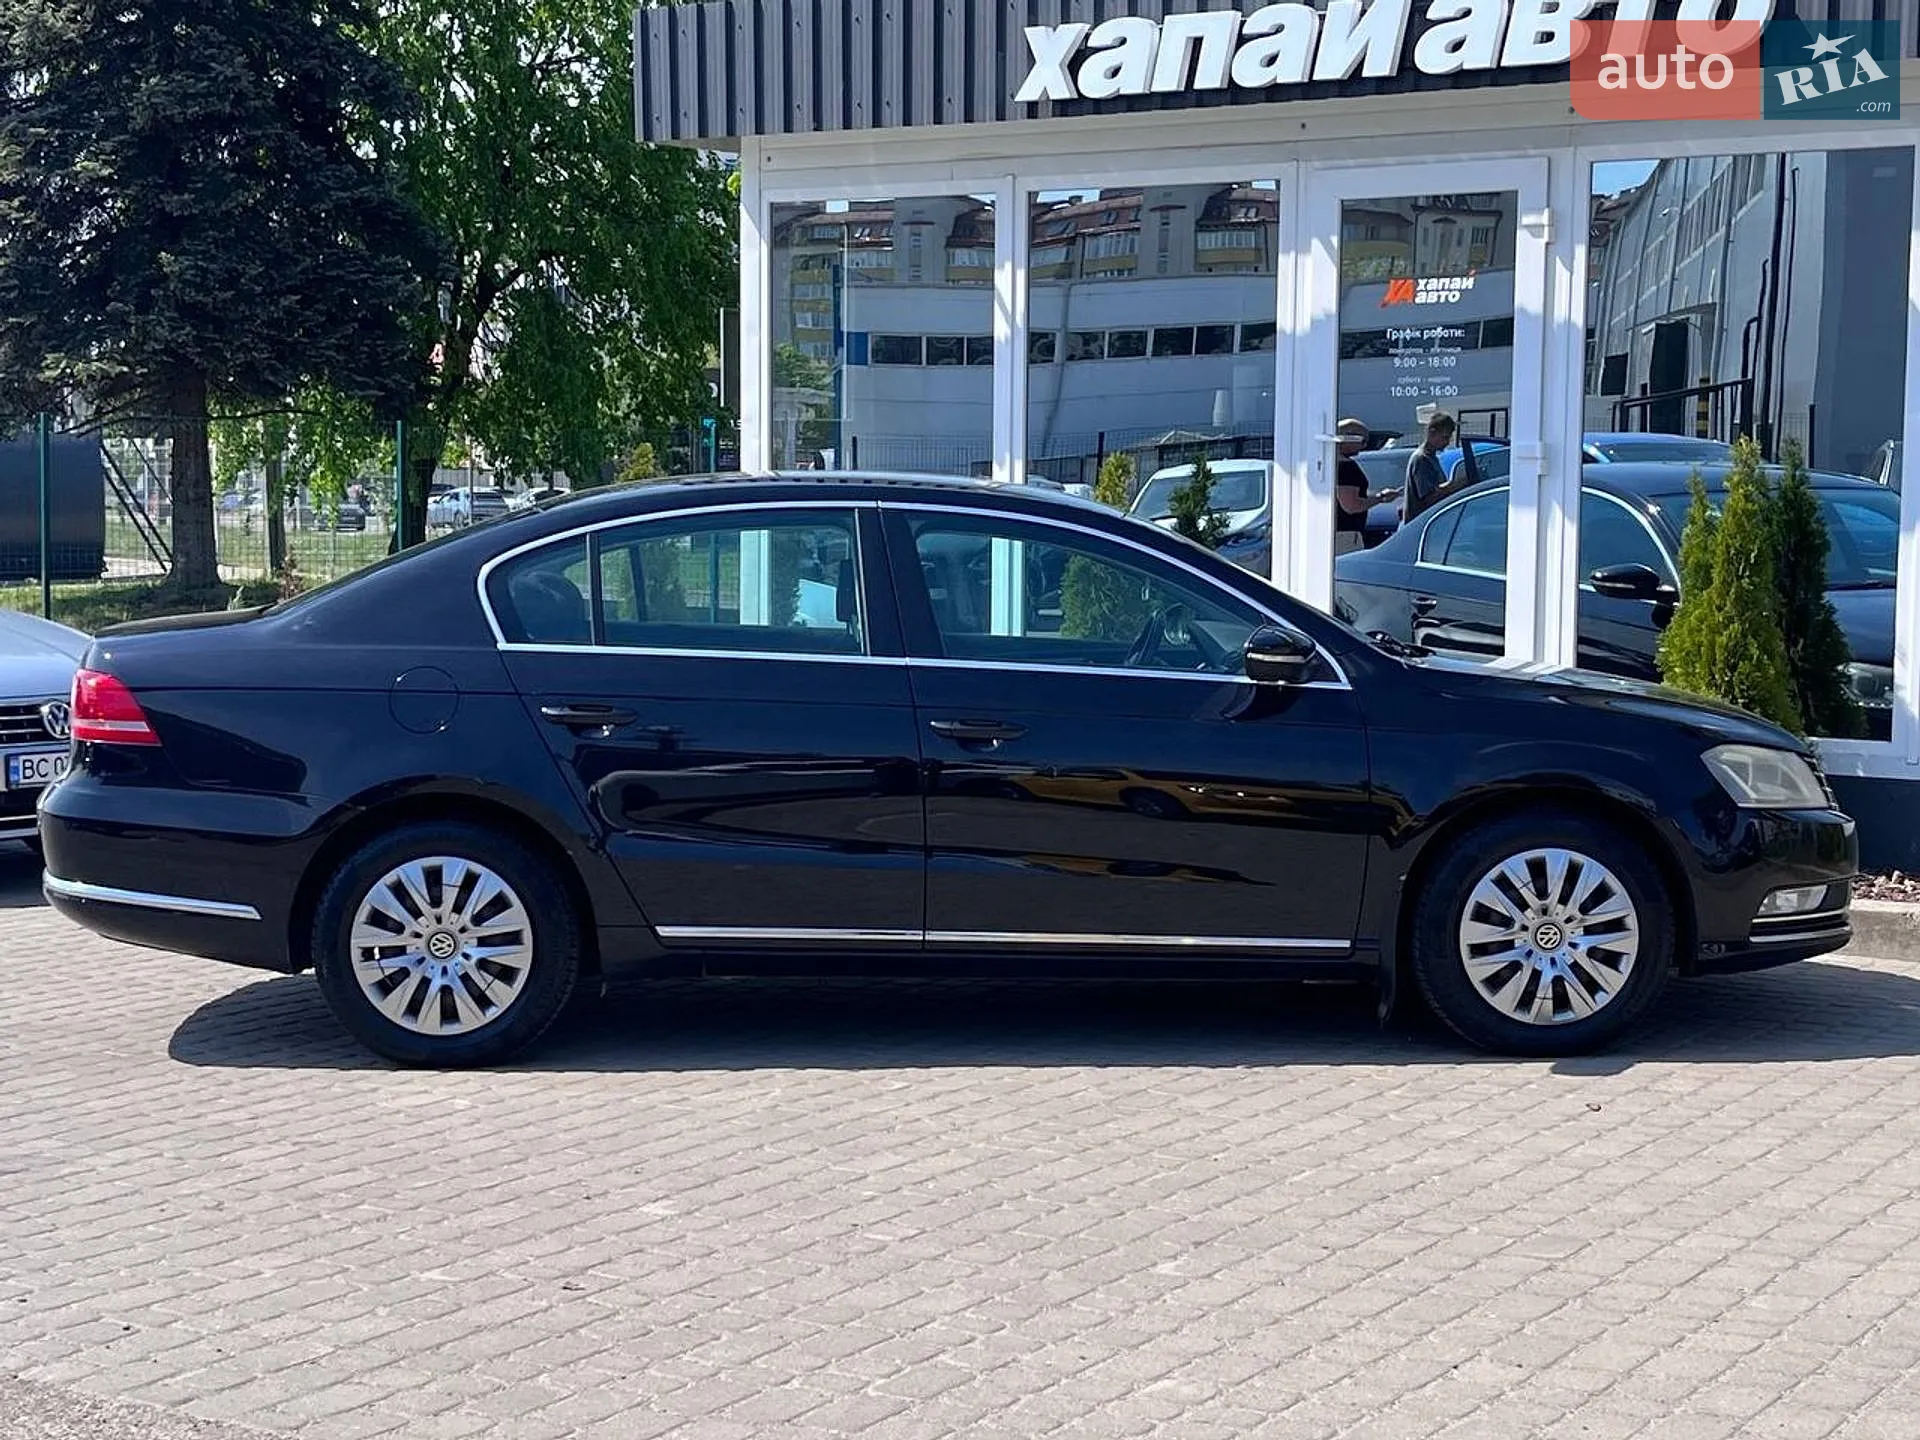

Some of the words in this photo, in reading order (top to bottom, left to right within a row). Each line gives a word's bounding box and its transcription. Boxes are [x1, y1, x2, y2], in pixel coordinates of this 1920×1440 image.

[1416, 270, 1476, 290] хапай
[1415, 291, 1460, 304] авто
[1428, 357, 1456, 367] 18:00
[1391, 386, 1418, 396] 10:00
[22, 758, 49, 779] BC
